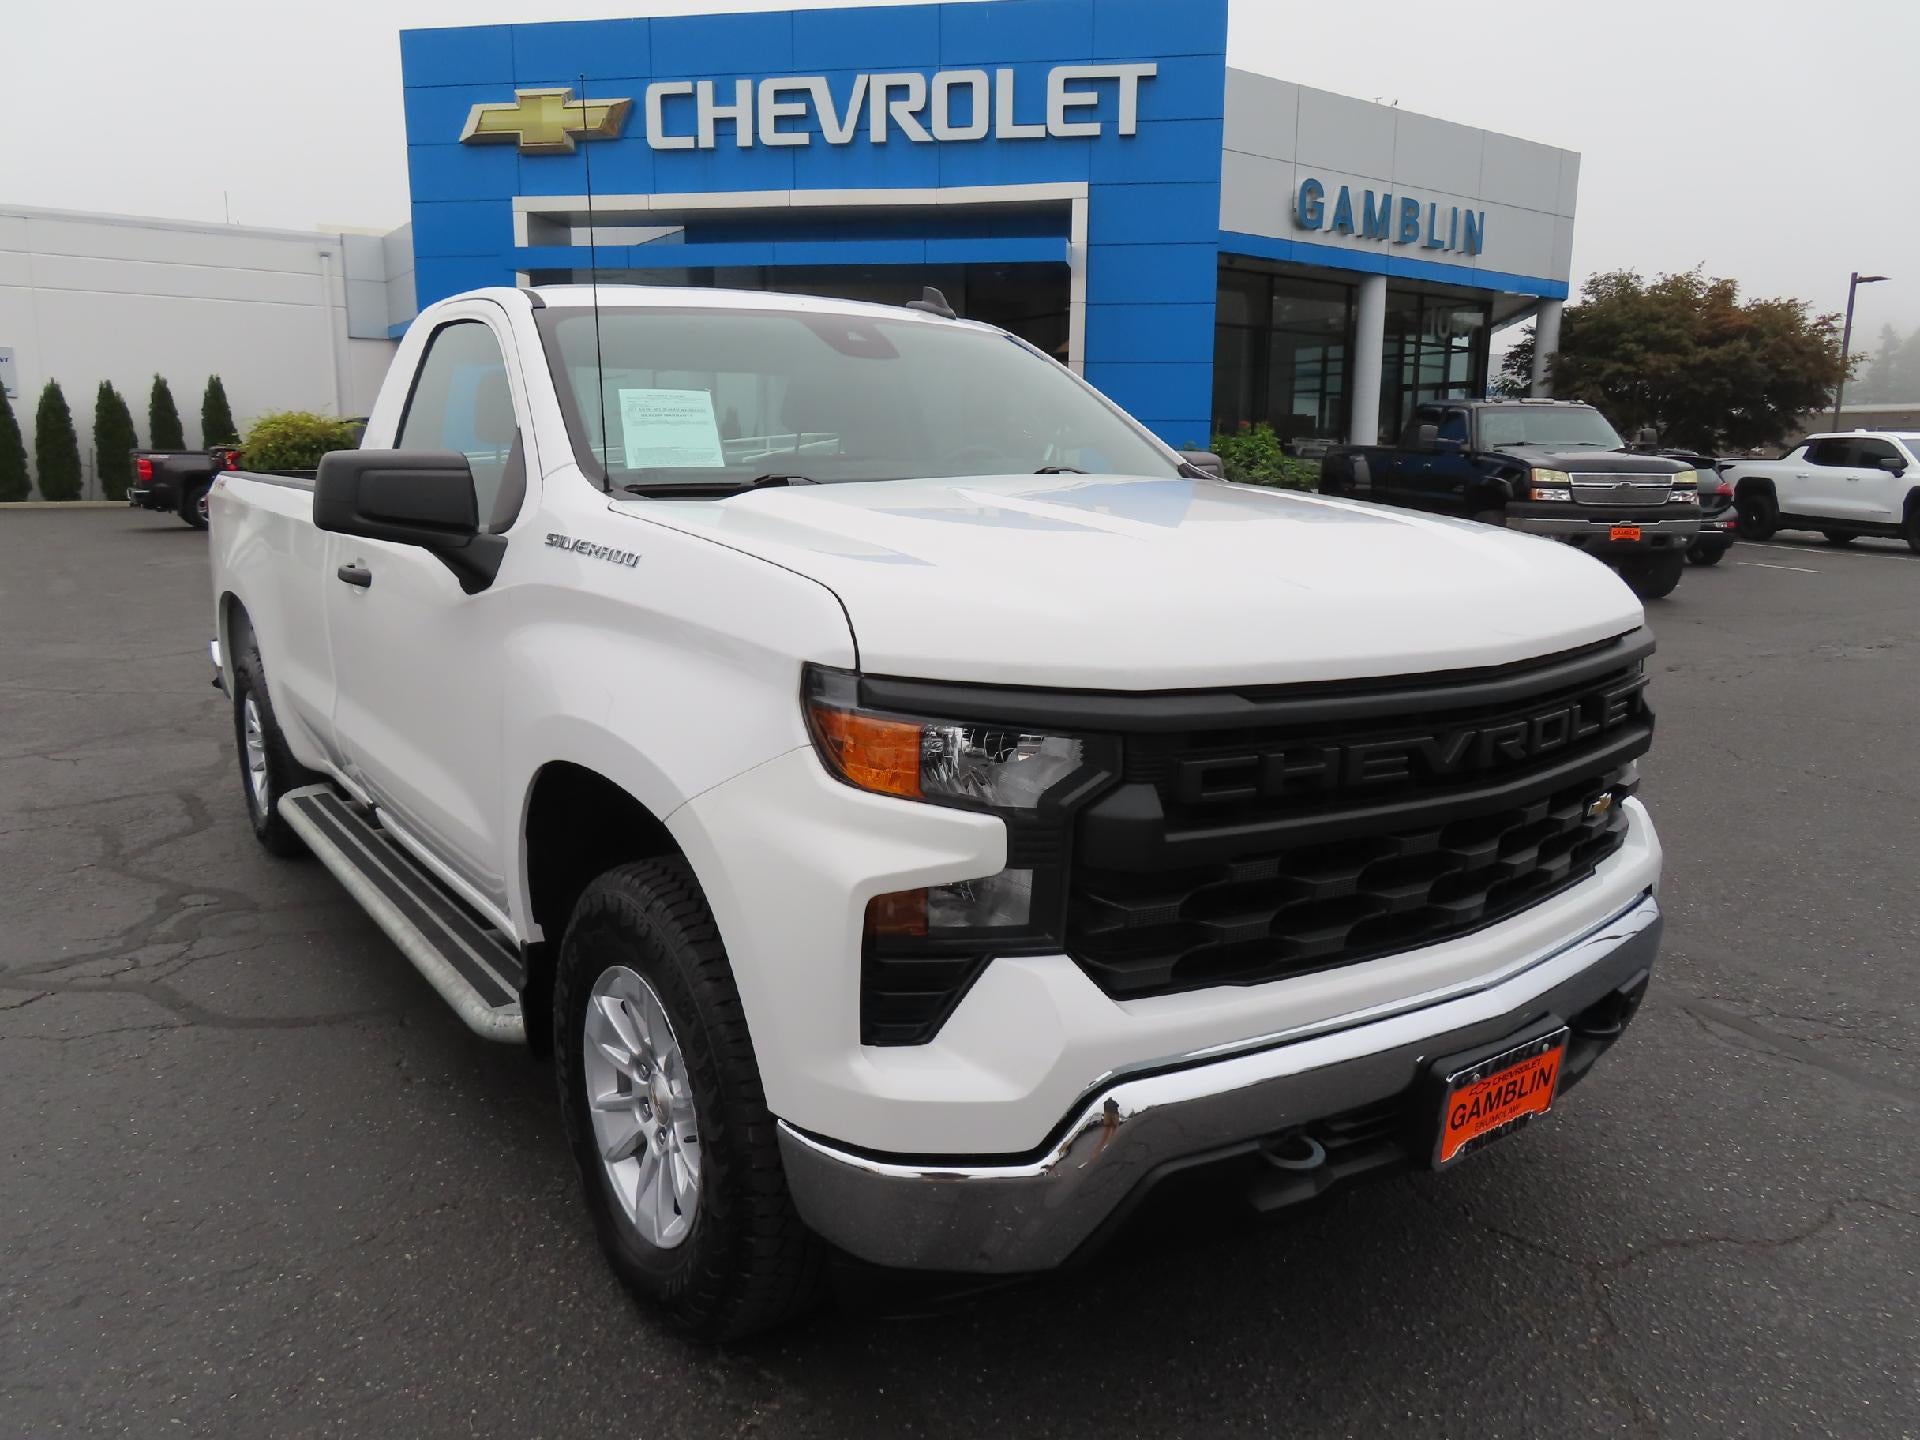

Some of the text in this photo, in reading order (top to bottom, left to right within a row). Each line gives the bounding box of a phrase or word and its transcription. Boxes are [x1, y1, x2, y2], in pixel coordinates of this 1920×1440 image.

[645, 63, 1157, 149] CHEVROLET
[1298, 178, 1485, 255] GAMBLIN
[1451, 1064, 1553, 1130] GAMBLIN
[1492, 1059, 1541, 1085] CHEVROLET
